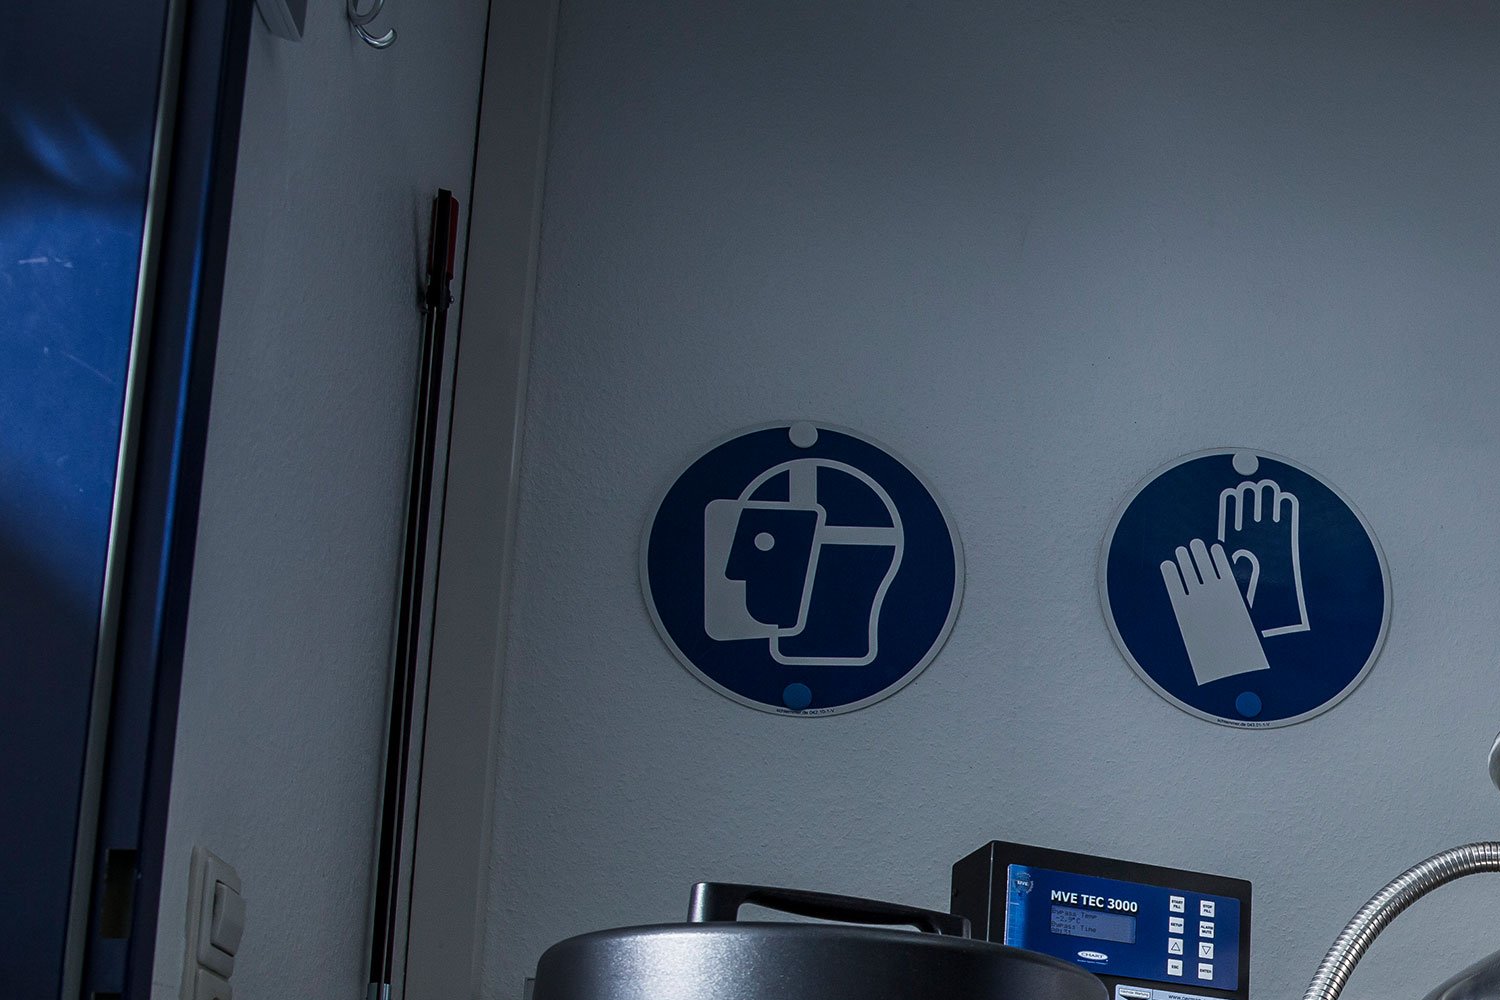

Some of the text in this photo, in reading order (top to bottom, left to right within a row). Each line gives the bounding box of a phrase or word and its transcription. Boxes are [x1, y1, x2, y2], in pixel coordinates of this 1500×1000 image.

[1051, 889, 1138, 913] MVE TEC 3000
